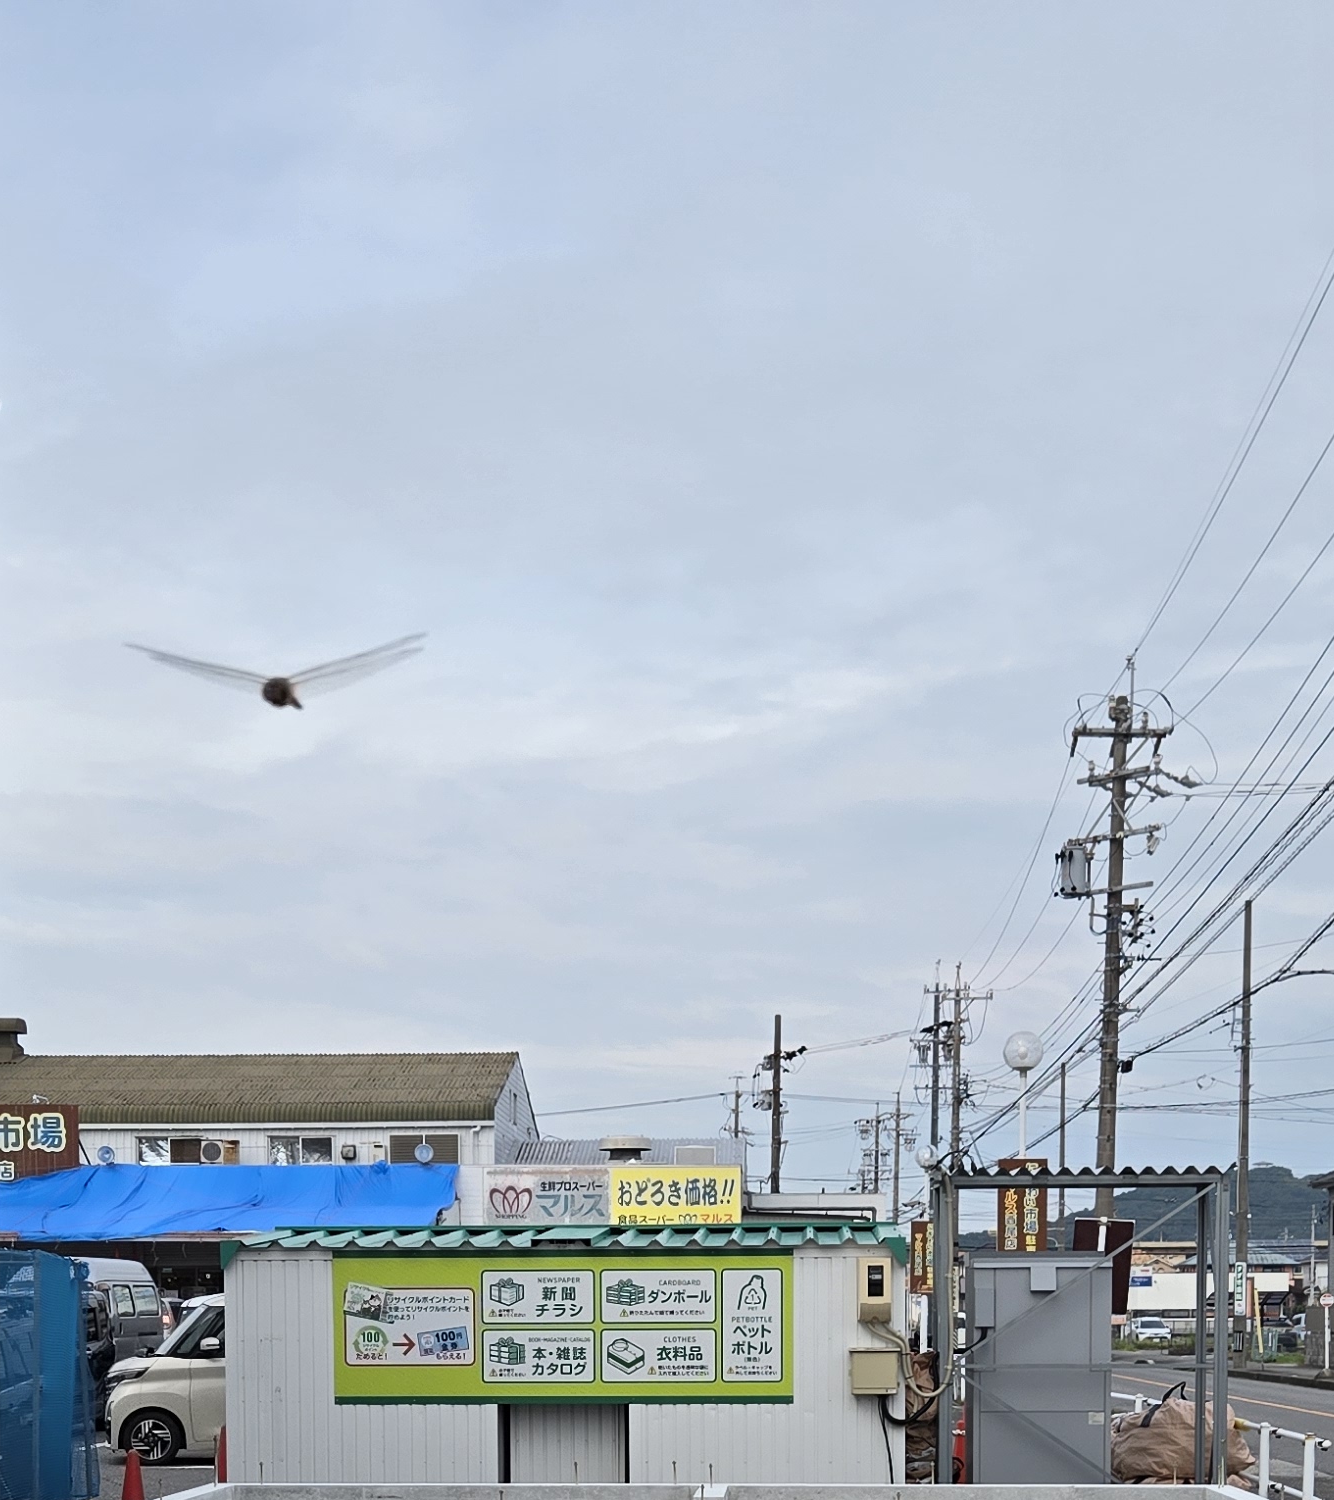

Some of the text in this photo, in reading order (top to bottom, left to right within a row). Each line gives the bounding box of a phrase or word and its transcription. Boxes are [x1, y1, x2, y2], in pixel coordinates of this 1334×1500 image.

[535, 1194, 606, 1217] マルス
[701, 1213, 734, 1224] マルス
[542, 1286, 576, 1301] 新聞
[647, 1290, 712, 1304] ダンボール
[535, 1304, 583, 1317] チラシ
[361, 1331, 380, 1343] 100
[733, 1324, 771, 1338] ペット
[532, 1346, 587, 1361] 本・雑誌
[656, 1346, 703, 1361] 衣料品
[731, 1341, 773, 1355] ボトル
[532, 1362, 587, 1376] カタログ
